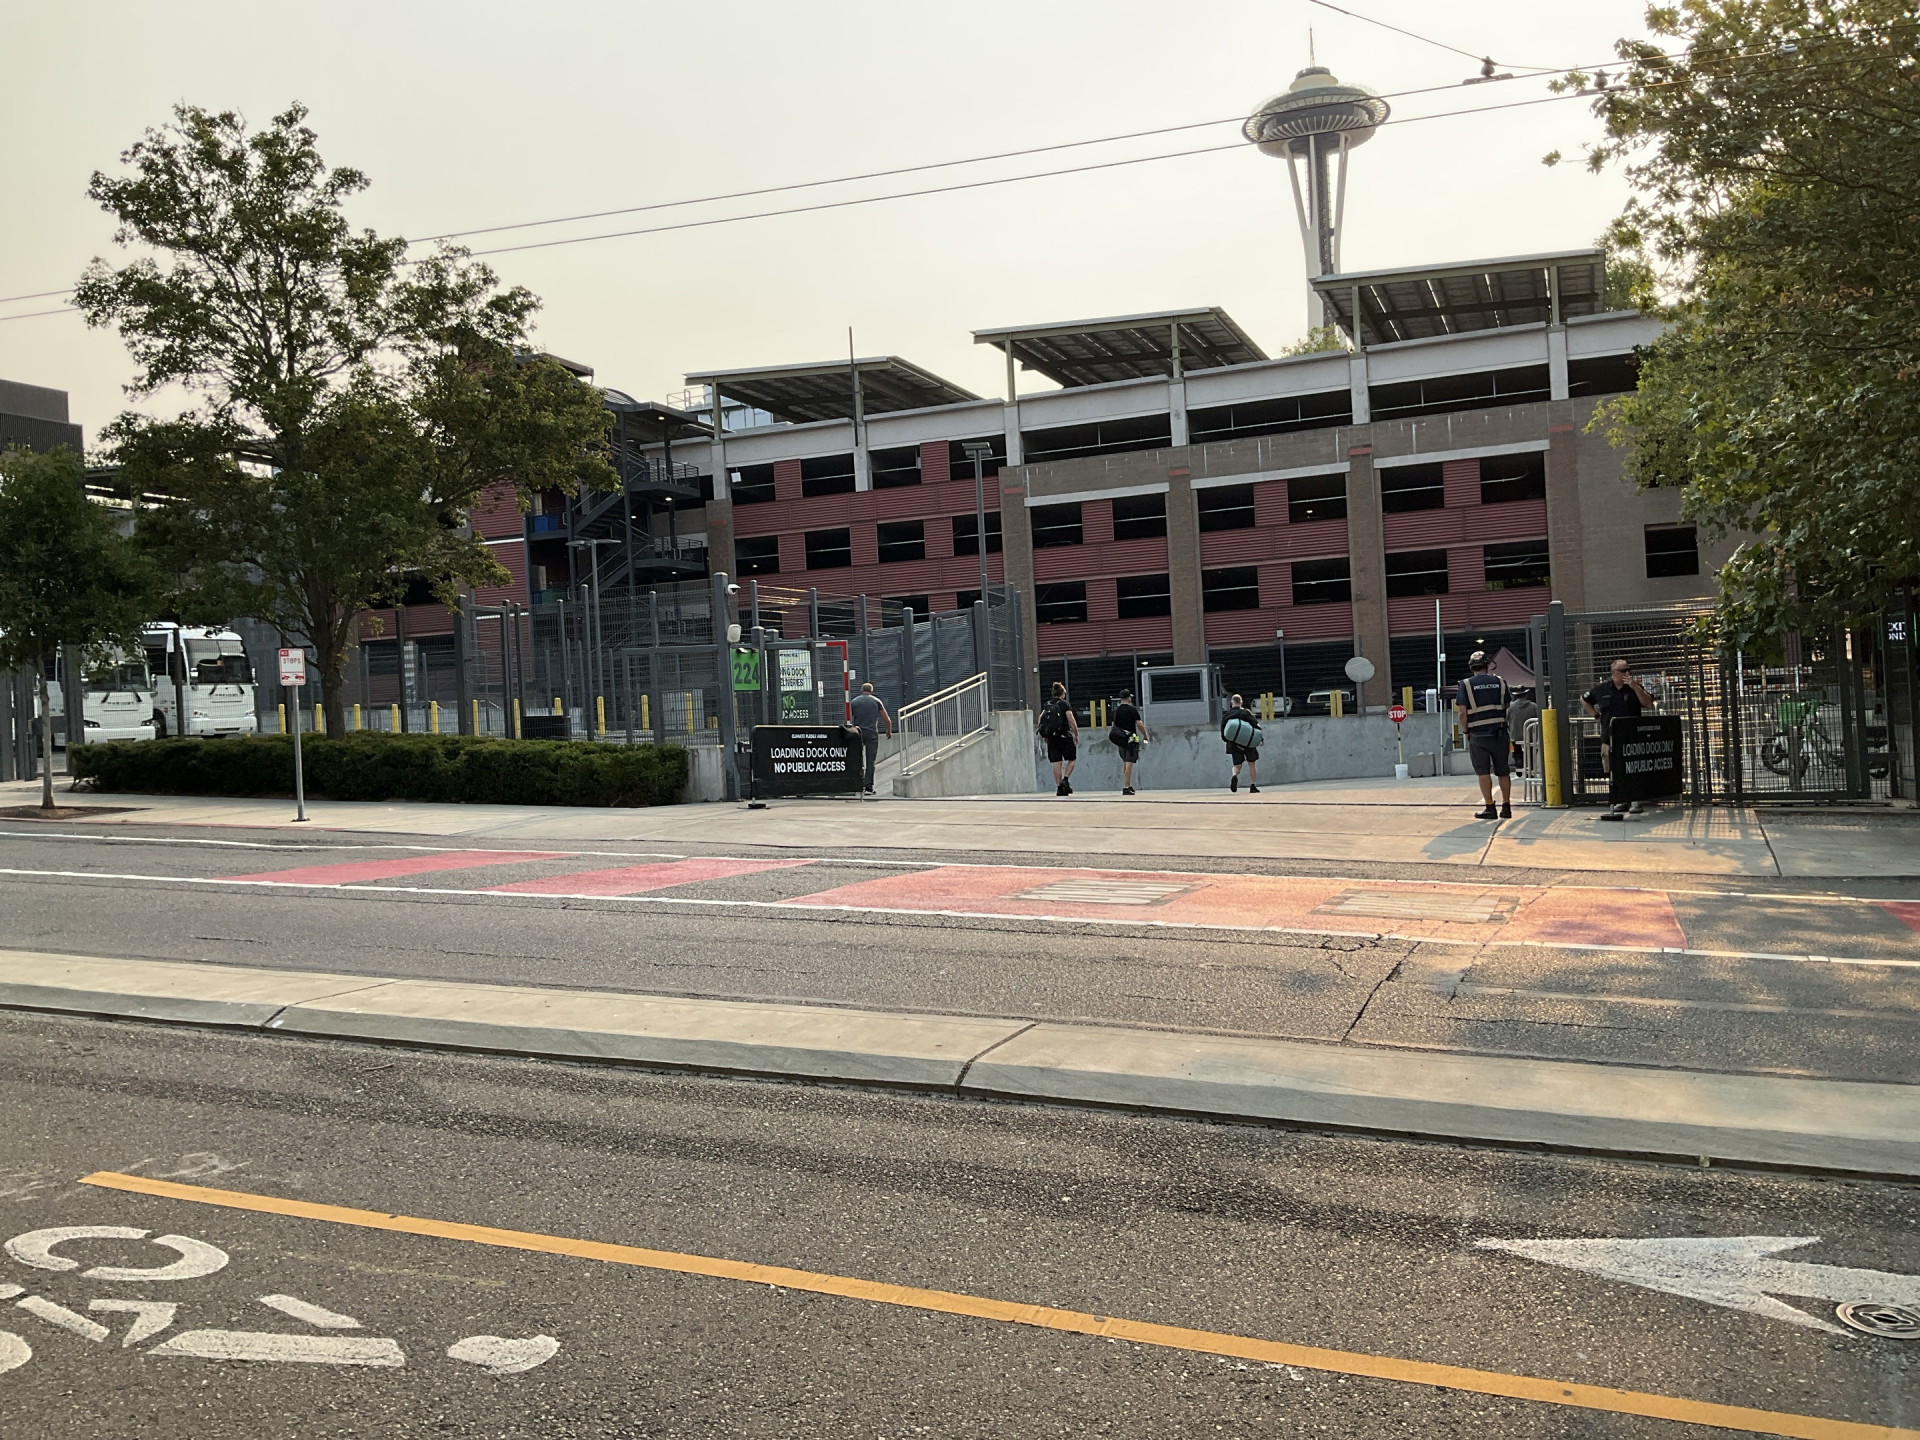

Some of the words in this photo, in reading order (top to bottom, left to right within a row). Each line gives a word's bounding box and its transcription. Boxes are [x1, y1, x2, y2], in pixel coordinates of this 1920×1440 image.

[1888, 622, 1906, 631] EXI
[734, 662, 760, 684] 224
[792, 667, 806, 676] DOCK
[781, 679, 804, 687] ELIVERIES
[783, 696, 795, 709] NO
[789, 709, 809, 718] ACCESS
[1389, 710, 1407, 719] STOP
[771, 748, 804, 758] LOADING
[806, 747, 828, 758] DOCK
[830, 747, 847, 758] ONLY
[1623, 742, 1645, 756] LOADING
[1646, 741, 1661, 753] DOCK
[1662, 740, 1674, 752] ONLY
[774, 762, 786, 773] NO
[787, 762, 814, 773] PUBLIC
[816, 761, 846, 772] ACCESS
[1634, 759, 1653, 772] PUBLIC
[1654, 757, 1673, 770] ACCESS
